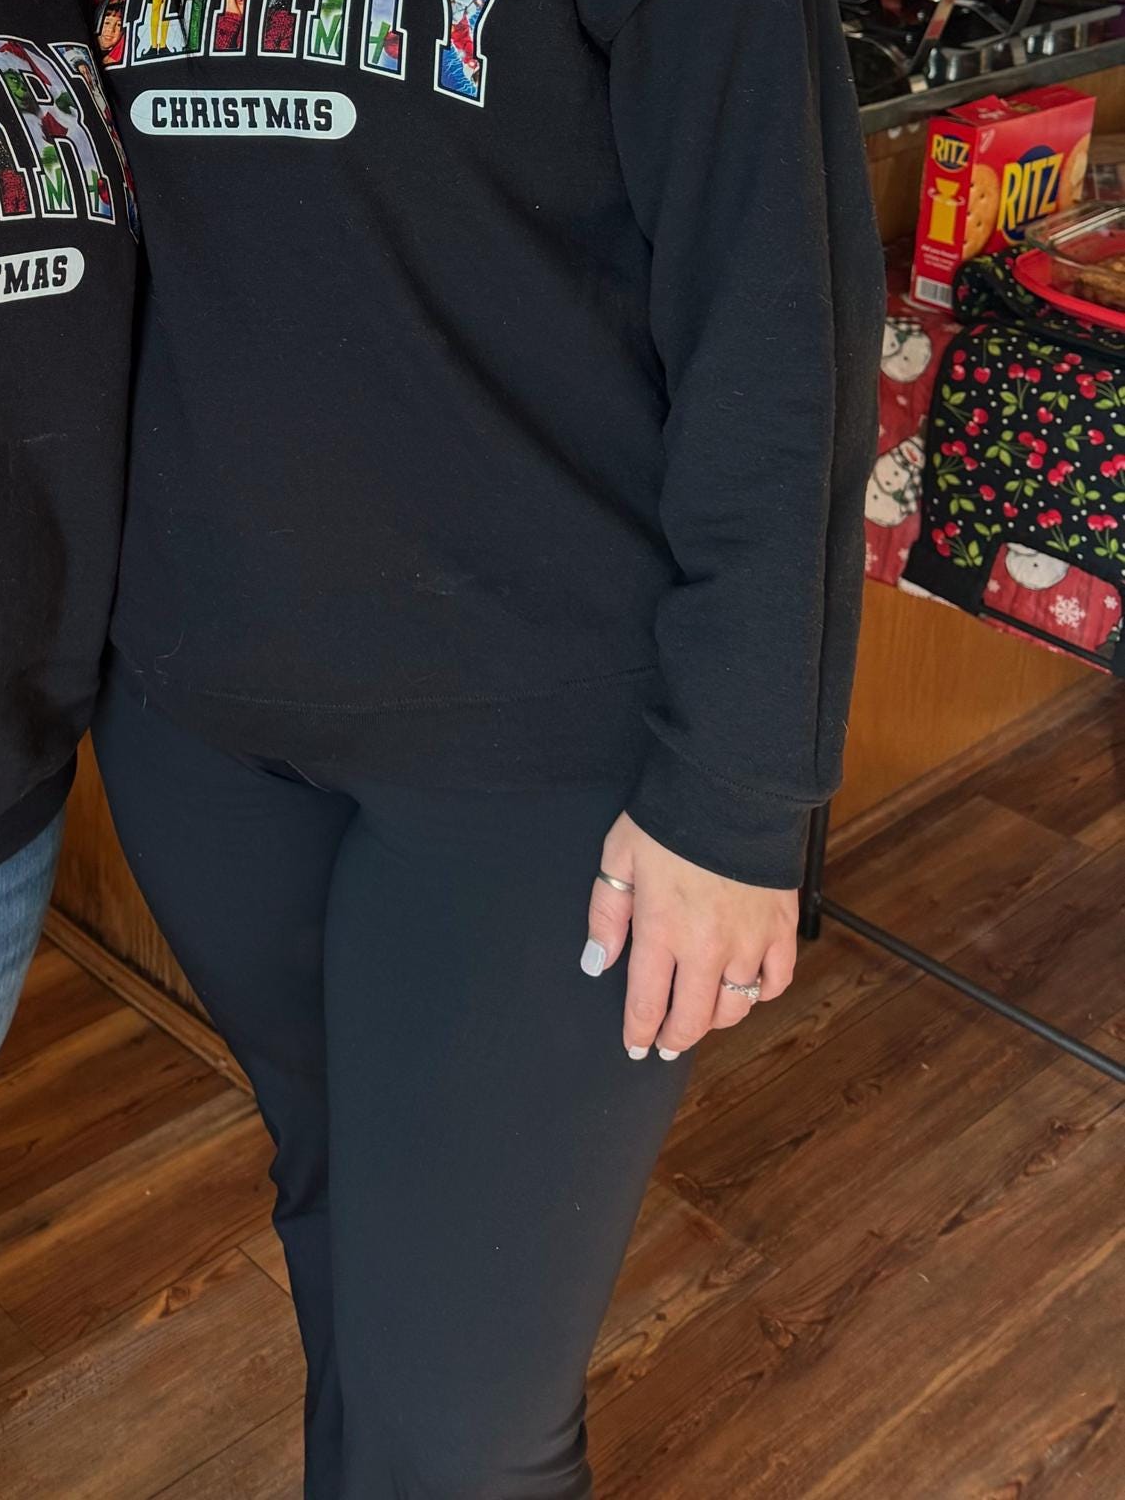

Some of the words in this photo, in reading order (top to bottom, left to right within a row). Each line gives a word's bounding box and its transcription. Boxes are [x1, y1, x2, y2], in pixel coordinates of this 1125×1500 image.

[151, 97, 333, 132] CHRISTMAS
[931, 133, 971, 167] RITZ
[996, 152, 1064, 231] RITZ
